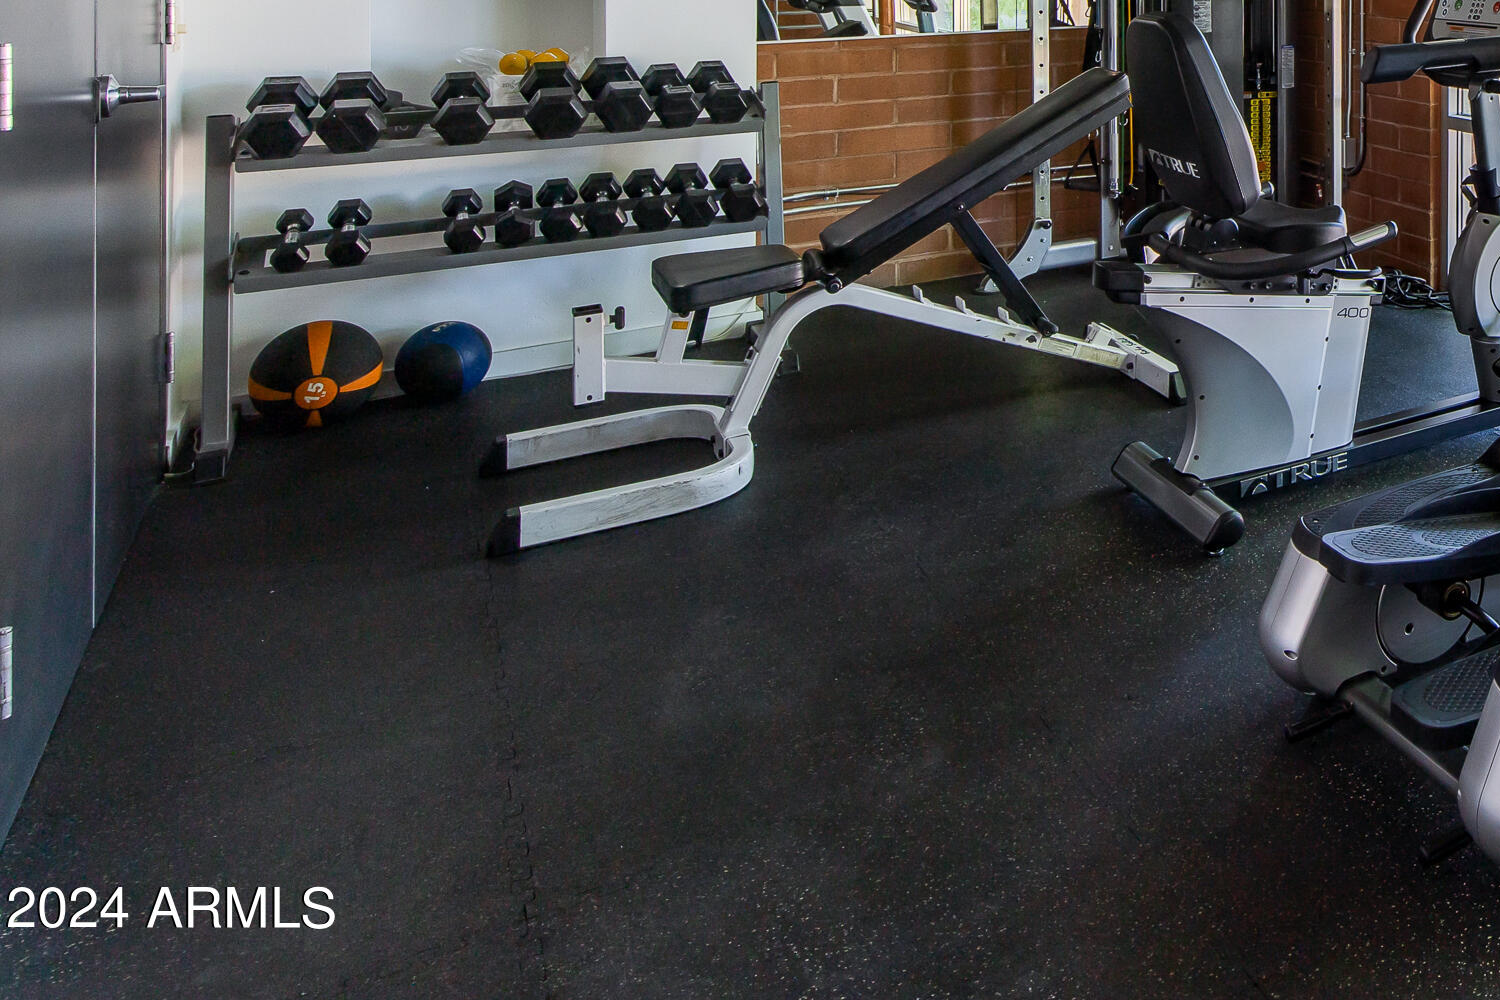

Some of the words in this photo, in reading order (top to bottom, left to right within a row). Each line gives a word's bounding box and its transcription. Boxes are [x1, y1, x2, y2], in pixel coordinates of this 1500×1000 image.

[1160, 152, 1201, 179] TRUE
[1336, 307, 1369, 319] 400
[1269, 451, 1348, 488] TRUE
